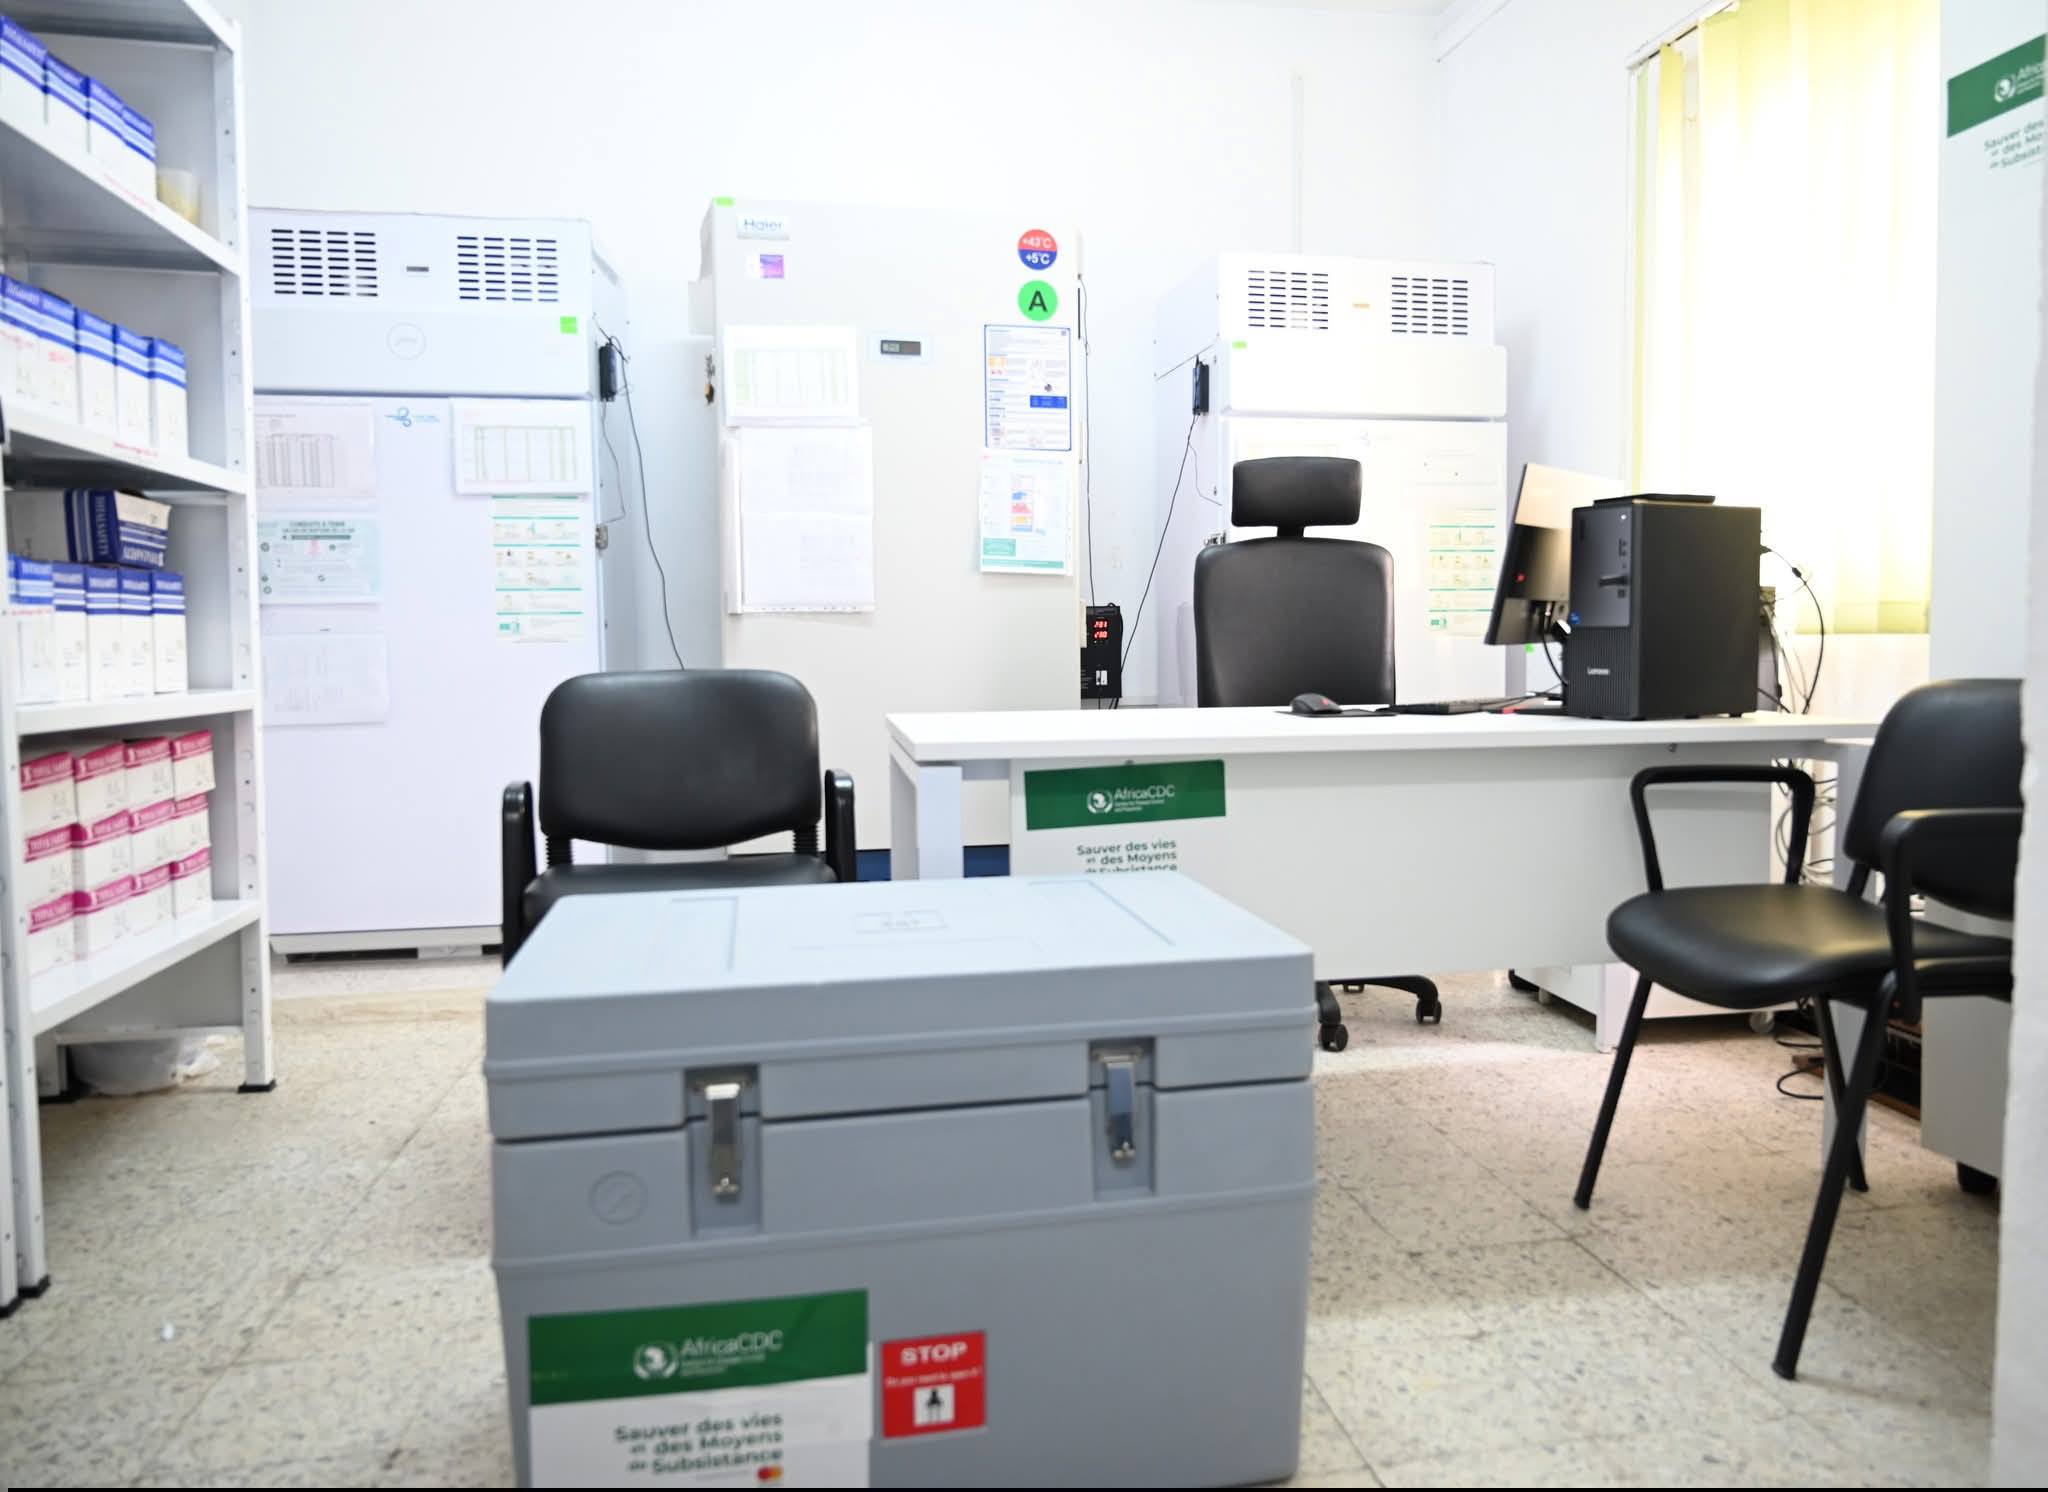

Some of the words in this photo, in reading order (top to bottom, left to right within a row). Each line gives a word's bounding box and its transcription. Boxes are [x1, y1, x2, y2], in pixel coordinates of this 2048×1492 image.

[744, 217, 783, 231] Haier
[1028, 289, 1048, 312] A
[1114, 785, 1175, 800] AfricaCDC
[1077, 843, 1121, 856] Sauver
[1125, 841, 1148, 852] des
[1152, 839, 1176, 849] vies
[1101, 855, 1123, 865] des
[1128, 851, 1177, 864] Moyens
[682, 1329, 784, 1357] AfricaCDC
[901, 1341, 968, 1367] STOP
[615, 1422, 690, 1443] Sauver
[696, 1416, 734, 1433] des
[741, 1411, 783, 1428] vies
[655, 1438, 693, 1454] des
[700, 1430, 783, 1449] Moyens
[653, 1449, 784, 1474] Subsistance
